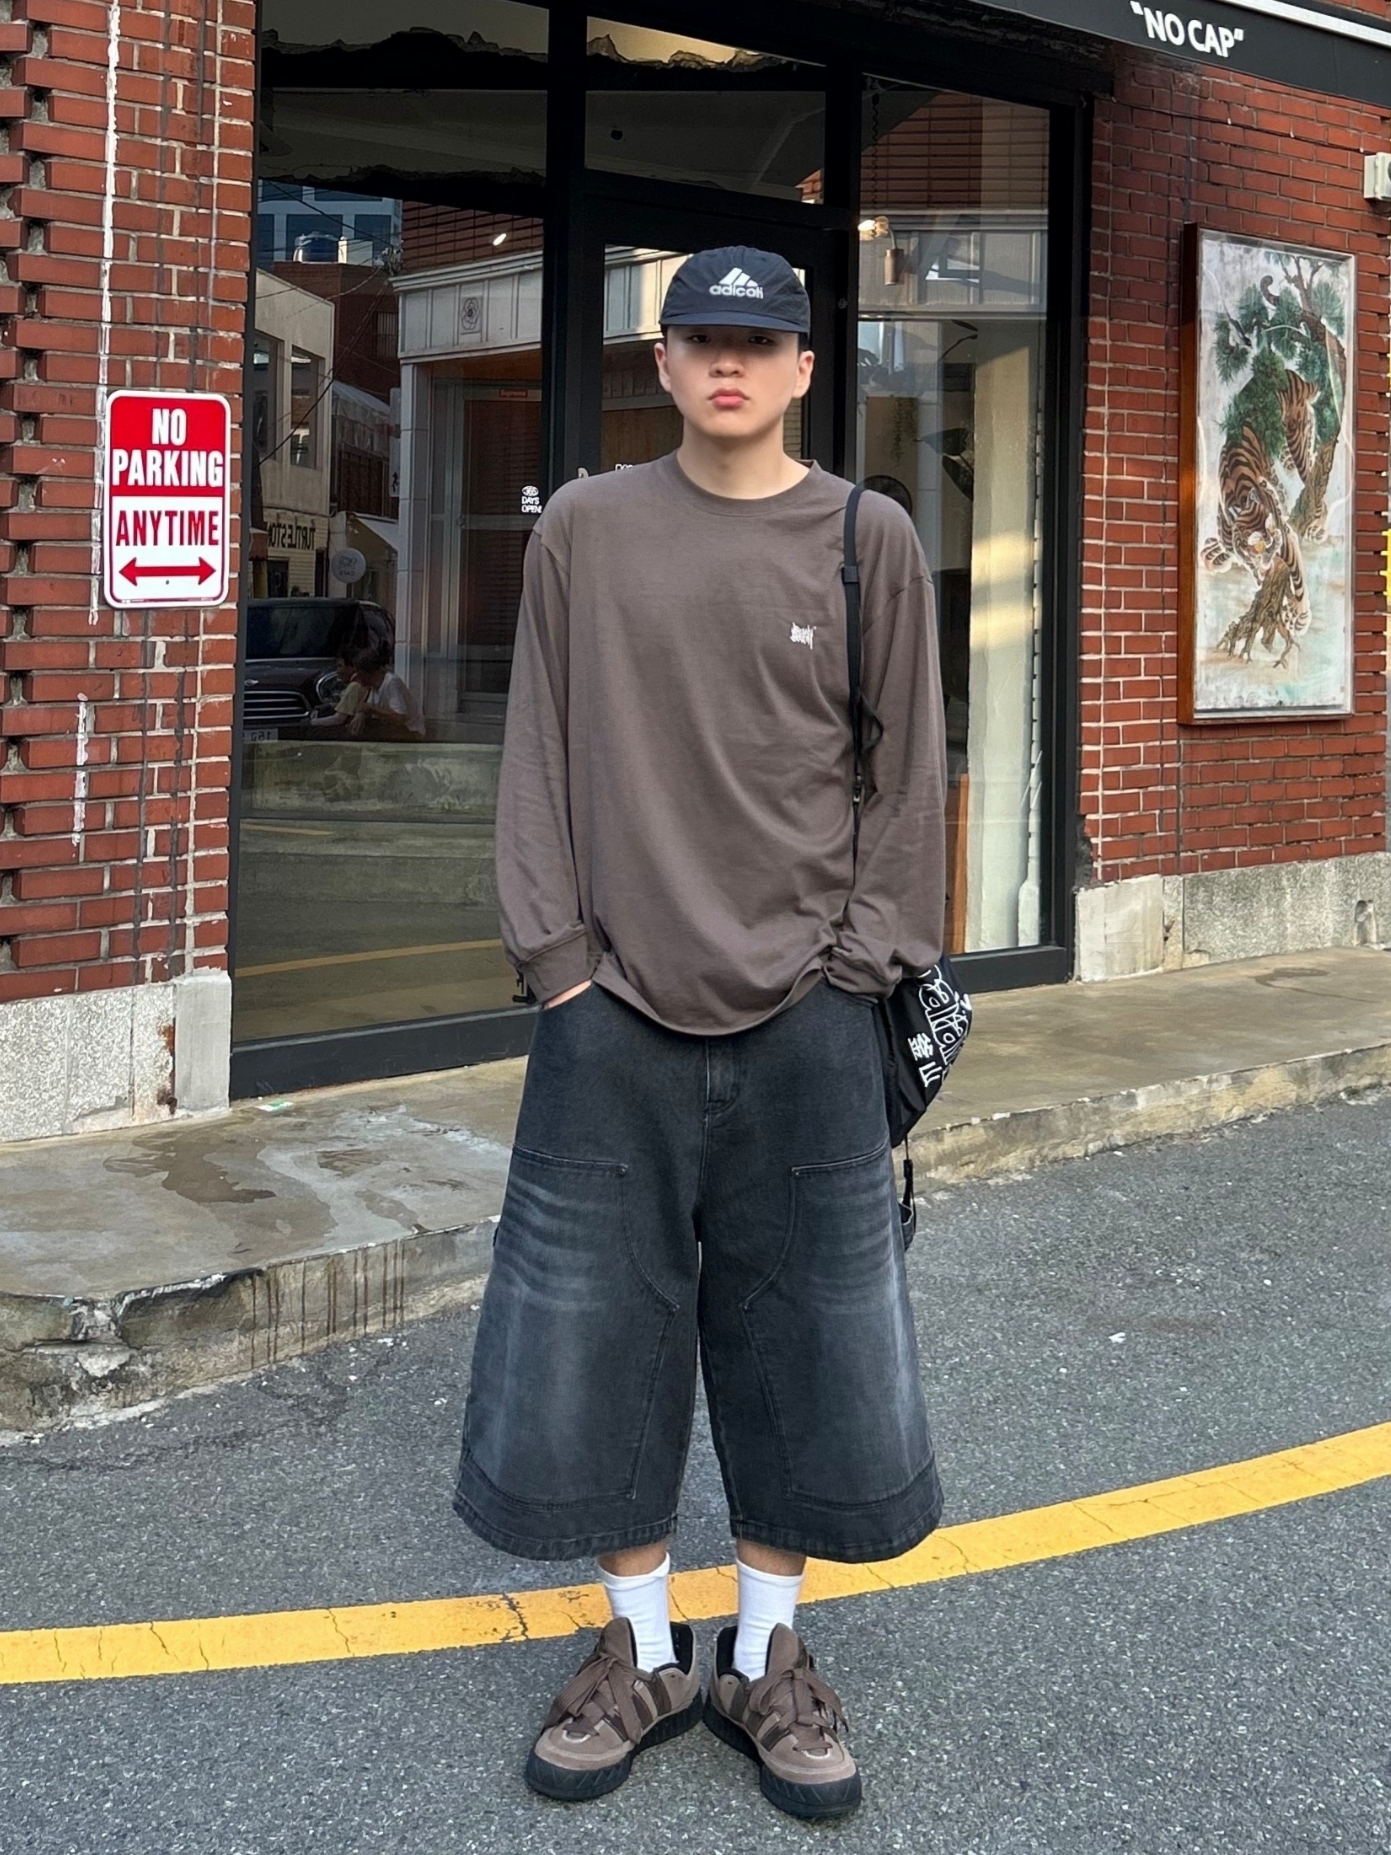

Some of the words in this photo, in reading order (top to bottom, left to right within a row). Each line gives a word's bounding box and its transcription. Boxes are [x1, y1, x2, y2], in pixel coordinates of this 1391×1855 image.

[151, 408, 187, 446] NO
[111, 448, 224, 487] PARKING
[521, 495, 540, 505] DAYS
[115, 510, 220, 547] ANYTIME
